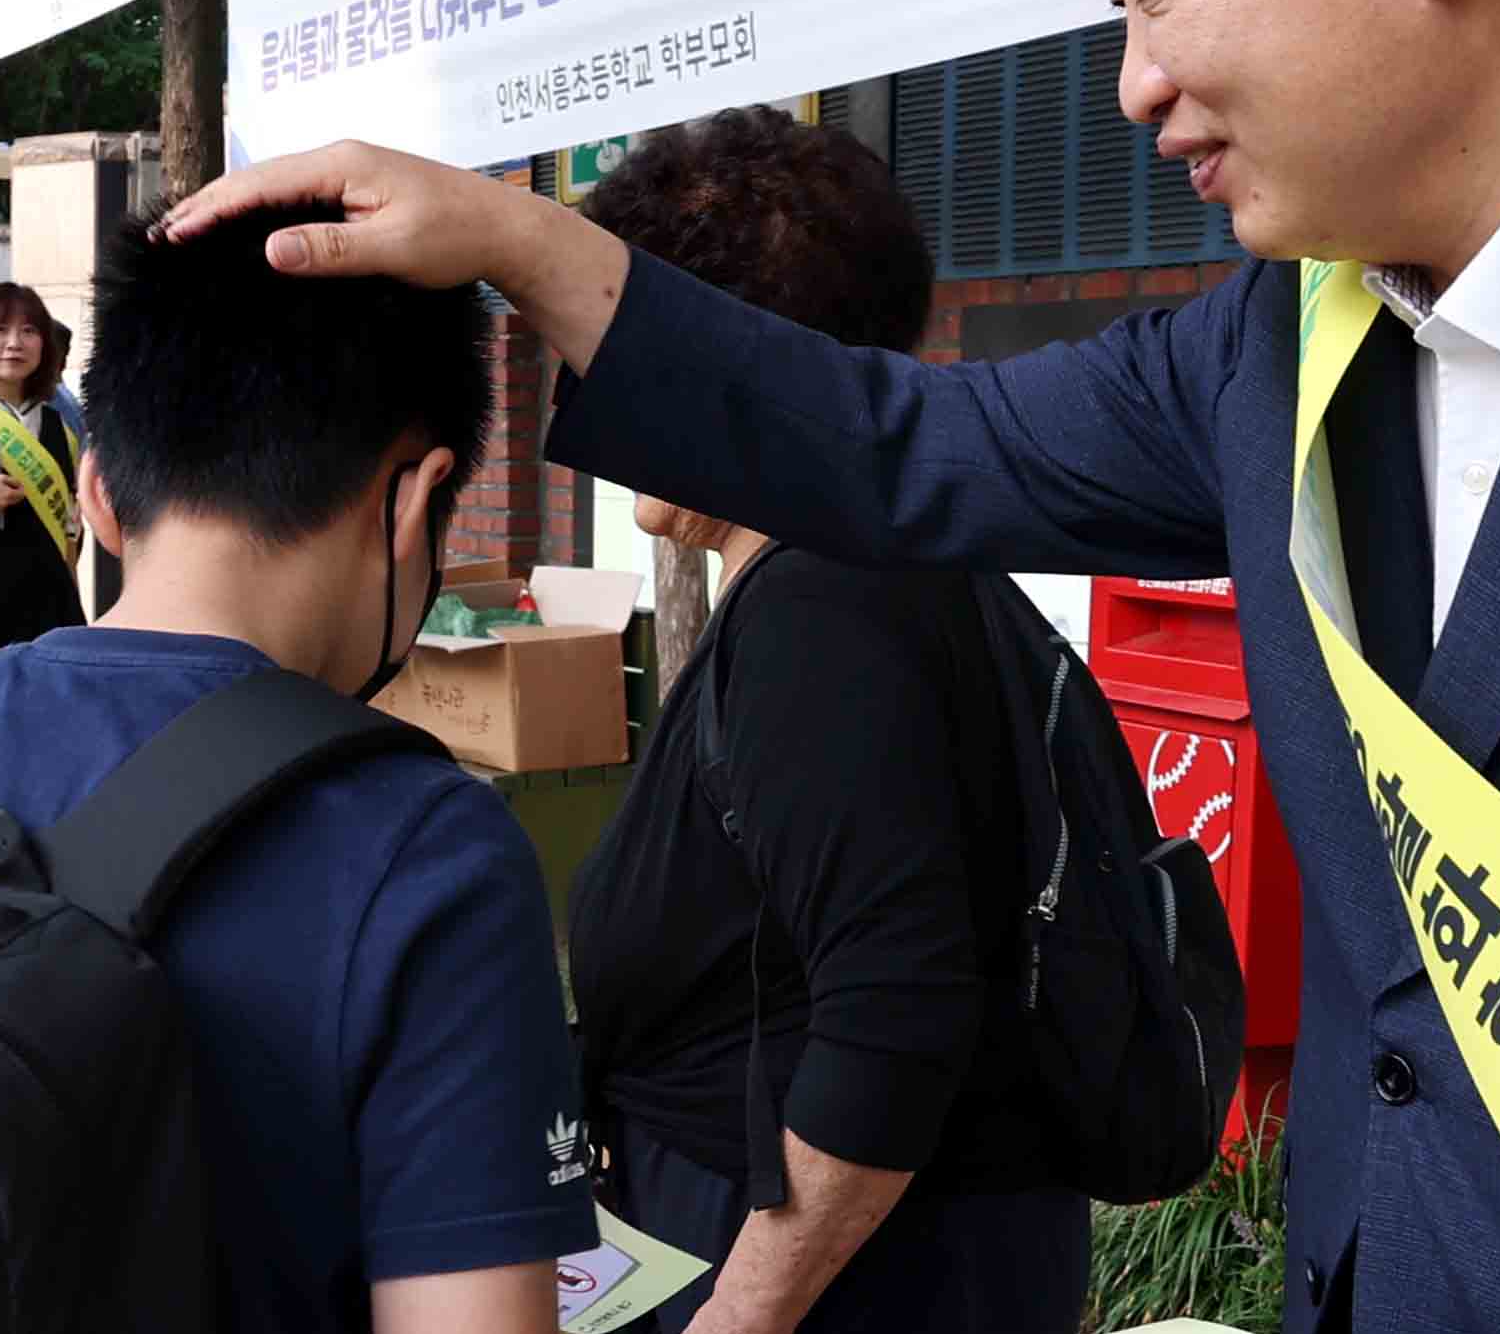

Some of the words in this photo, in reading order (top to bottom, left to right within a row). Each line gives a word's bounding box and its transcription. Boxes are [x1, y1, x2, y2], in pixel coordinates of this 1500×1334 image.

[262, 6, 340, 92] 음식물과
[496, 42, 656, 125] 인천서흥초등학교
[659, 9, 757, 80] 학부모회
